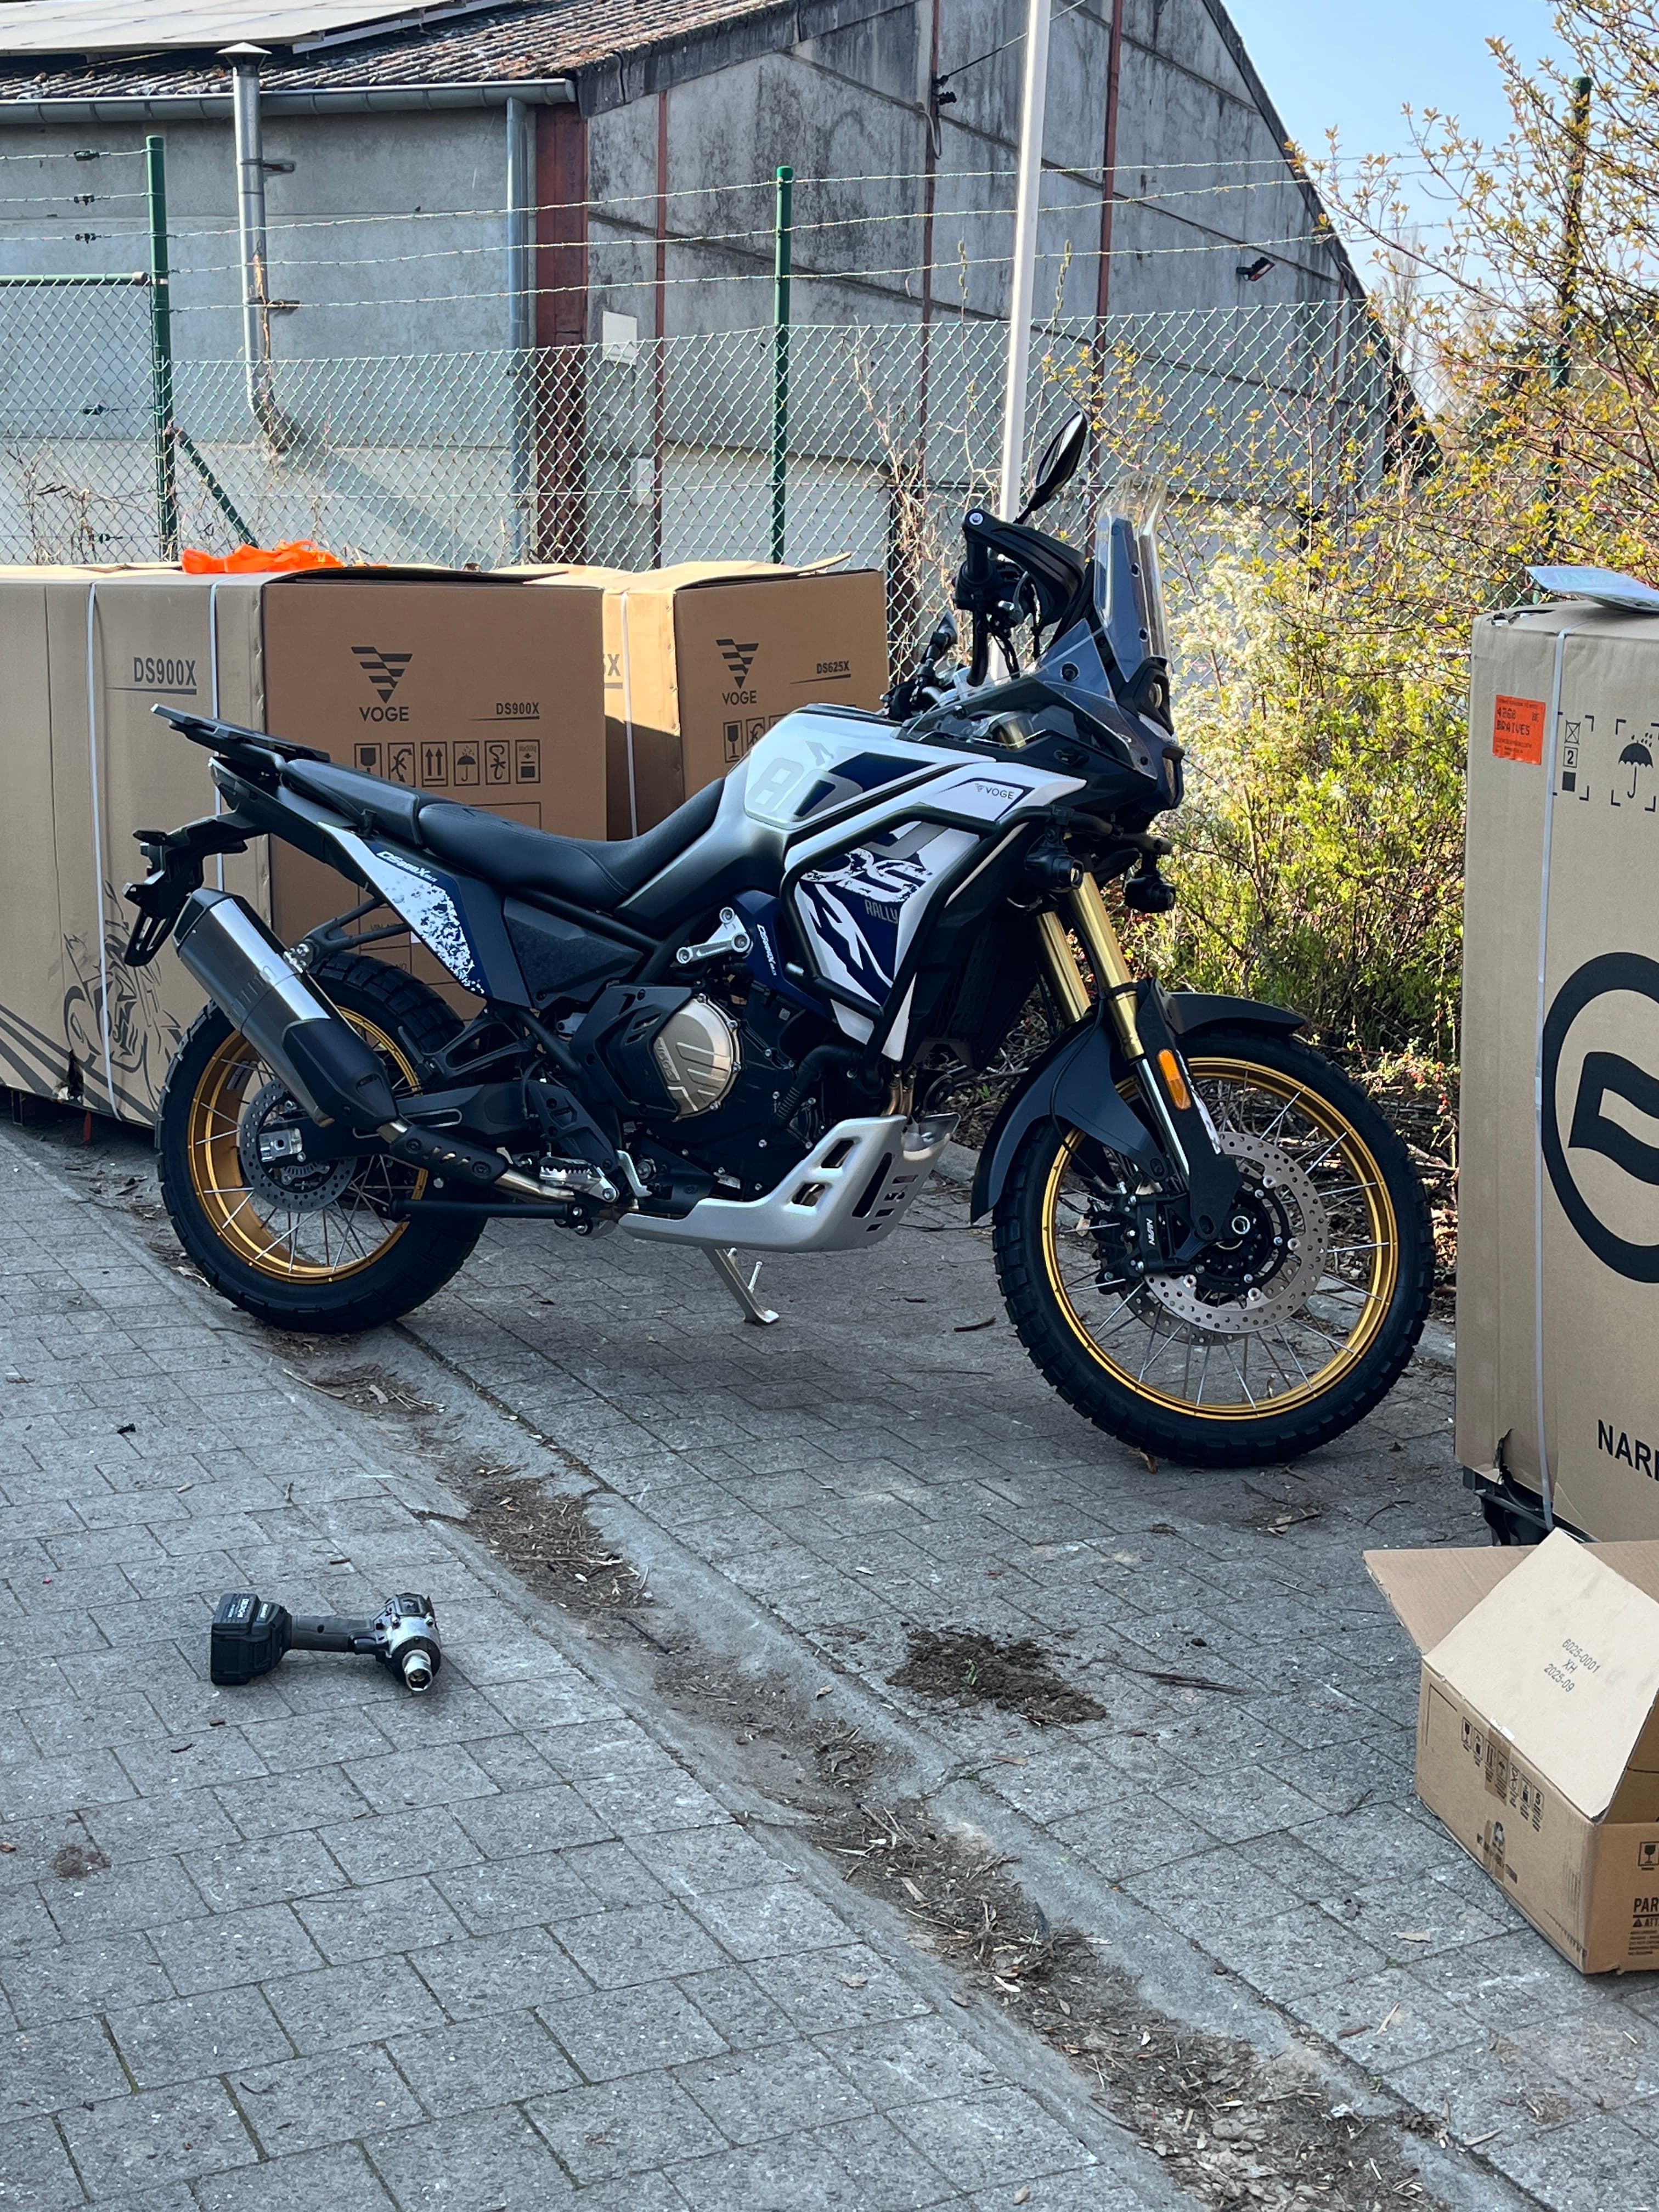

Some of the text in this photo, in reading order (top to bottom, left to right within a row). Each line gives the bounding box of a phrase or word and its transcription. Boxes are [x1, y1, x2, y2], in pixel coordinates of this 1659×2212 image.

[134, 657, 197, 686] DS900X
[816, 660, 850, 674] DS625X
[722, 690, 757, 706] VOGE
[359, 706, 409, 722] VOGE
[496, 702, 539, 715] DS900X
[985, 786, 1014, 800] VOGE
[864, 899, 899, 924] RALLY
[1598, 1419, 1659, 1482] NAR
[1562, 1638, 1601, 1674] 6025-0001
[1561, 1658, 1578, 1675] XH
[1544, 1663, 1575, 1692] 2025-09
